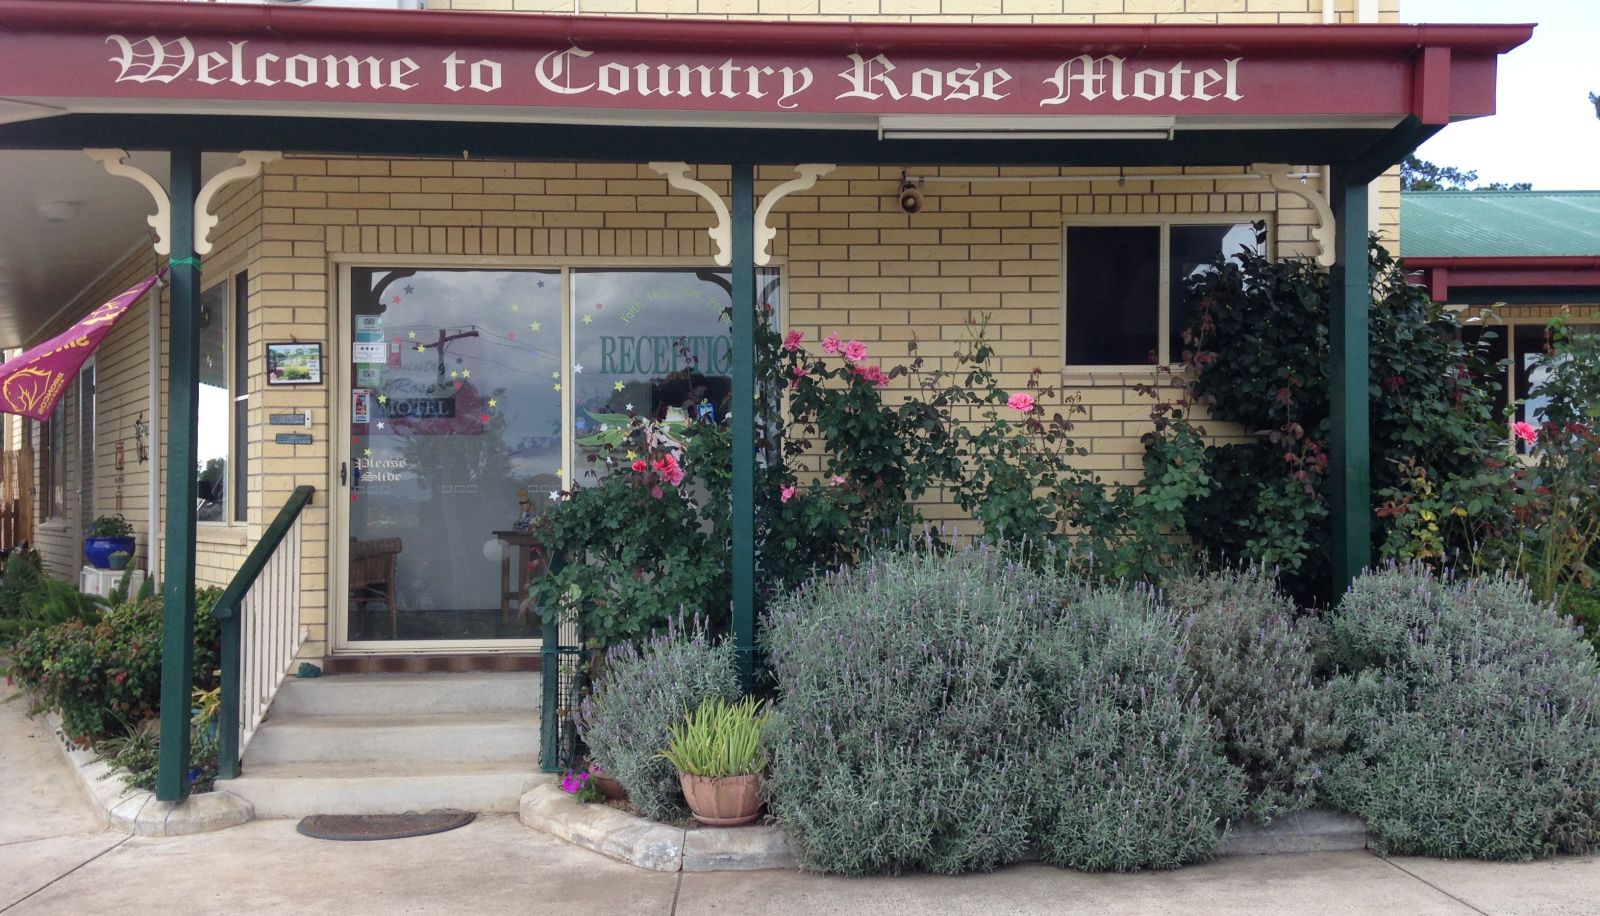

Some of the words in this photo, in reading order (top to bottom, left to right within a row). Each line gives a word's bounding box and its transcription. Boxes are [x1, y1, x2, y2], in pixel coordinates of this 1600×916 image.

[107, 35, 421, 91] Welcome
[442, 51, 502, 93] to
[534, 46, 814, 110] Country
[835, 53, 1013, 101] Rose
[1039, 53, 1244, 107] Motel
[599, 335, 733, 375] RECEPTIO
[380, 400, 449, 416] MOTEL
[353, 457, 407, 469] Please
[361, 471, 402, 482] Slide
